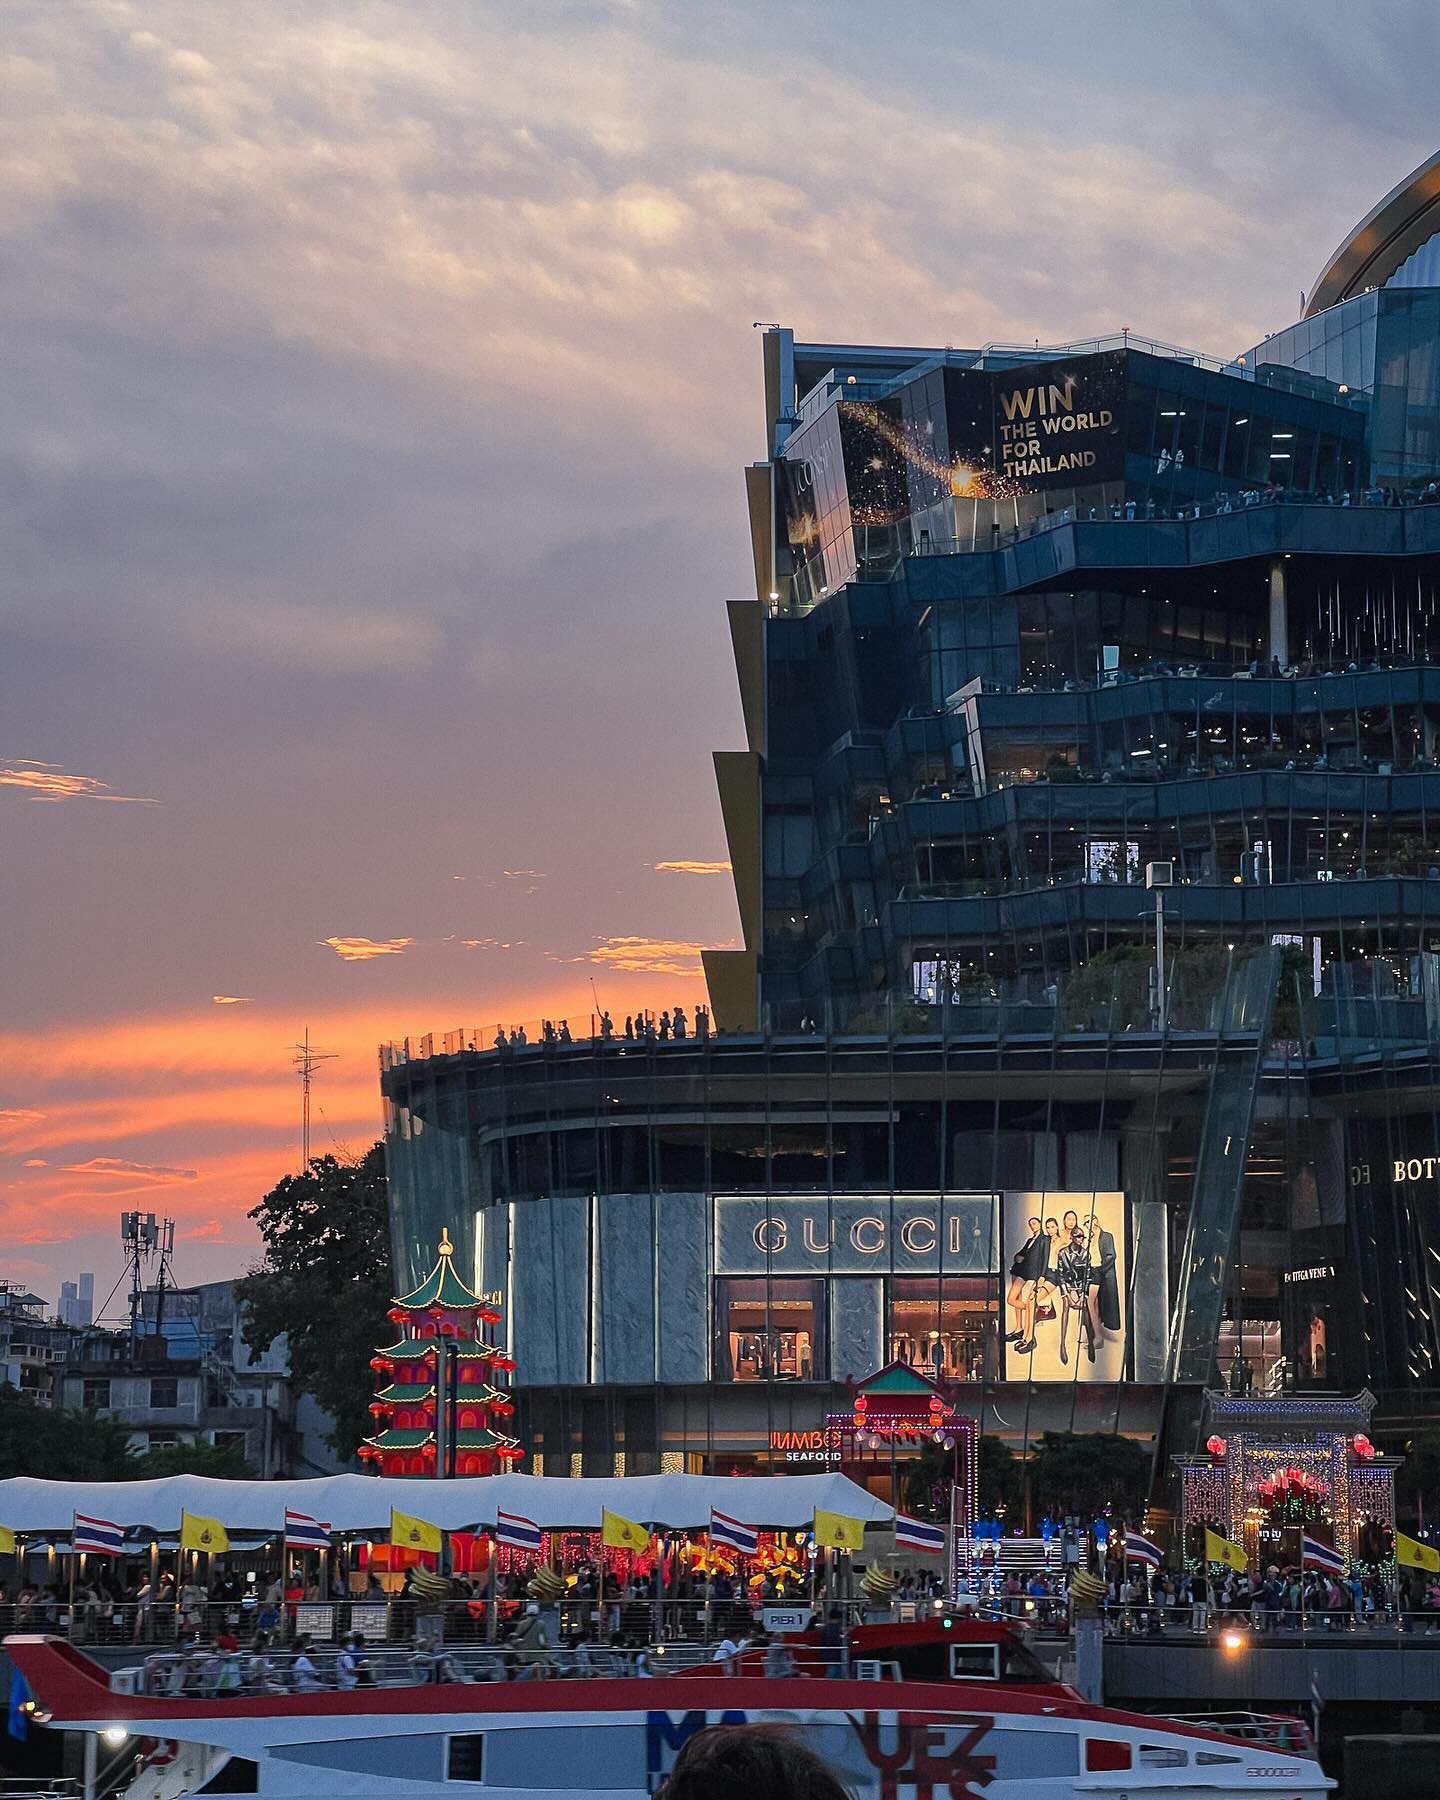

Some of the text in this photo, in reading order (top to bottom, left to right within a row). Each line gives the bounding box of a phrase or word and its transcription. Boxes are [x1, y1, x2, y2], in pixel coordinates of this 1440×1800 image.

[1000, 382, 1073, 420] WIN
[1000, 411, 1112, 440] THE WORLD
[1002, 440, 1041, 459] FOR
[1003, 451, 1096, 478] THAILAND
[1393, 1157, 1440, 1182] BOT
[753, 1217, 960, 1253] GUCCI
[770, 1613, 803, 1624] PIER 1
